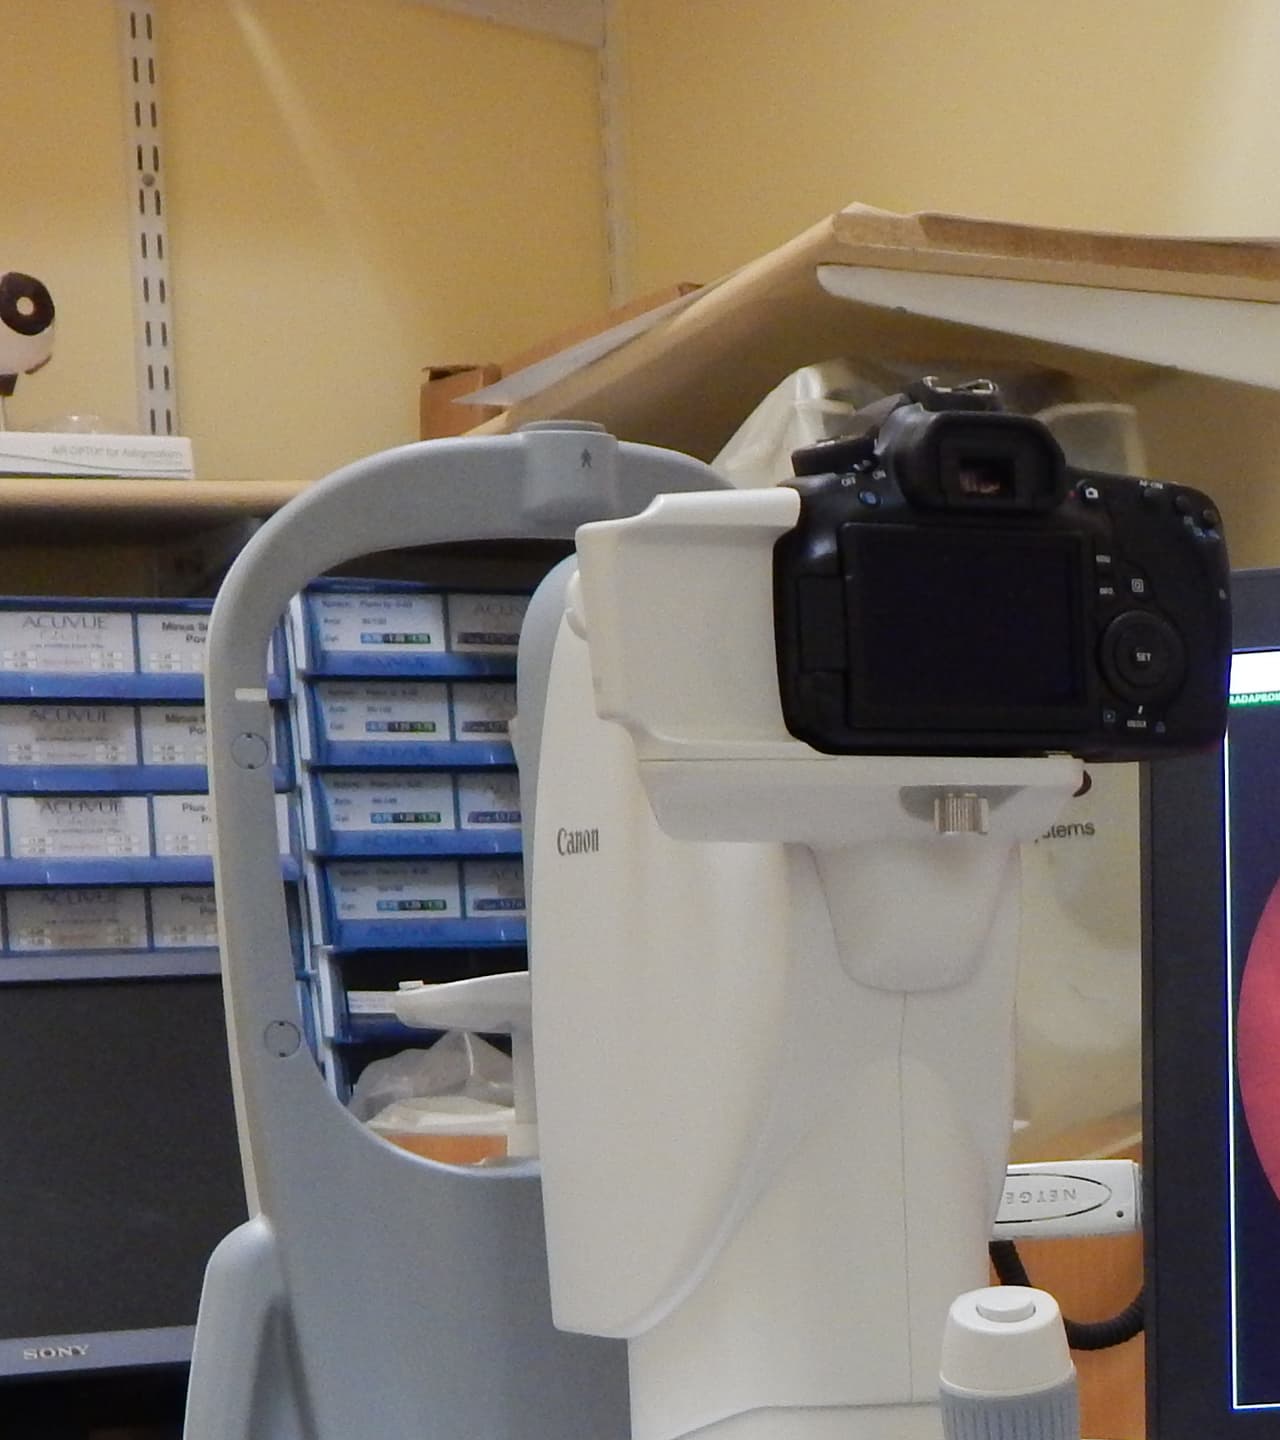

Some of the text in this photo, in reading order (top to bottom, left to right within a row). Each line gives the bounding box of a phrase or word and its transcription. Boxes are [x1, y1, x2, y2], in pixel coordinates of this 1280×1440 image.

[23, 615, 110, 630] ACUVUE
[162, 621, 196, 632] Minus
[1136, 652, 1151, 662] SET
[28, 707, 112, 723] ACUVUE
[39, 797, 126, 815] ACUVUE
[557, 827, 599, 857] Canon
[23, 1344, 89, 1361] SONY
